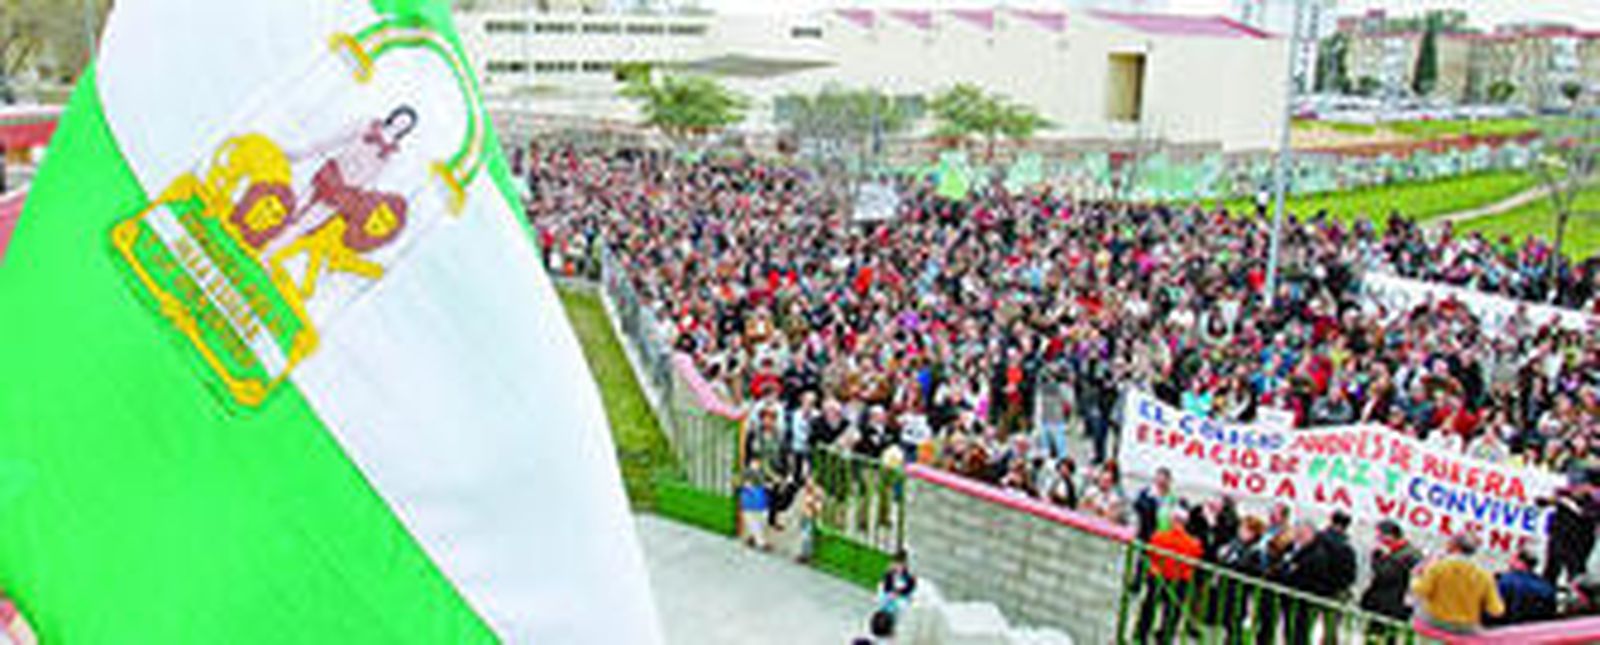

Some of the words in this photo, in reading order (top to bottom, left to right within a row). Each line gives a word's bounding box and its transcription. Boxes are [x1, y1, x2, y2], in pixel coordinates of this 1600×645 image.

[1138, 398, 1167, 426] EL
[1136, 423, 1261, 470] ESPACIO
[1268, 453, 1299, 474] DE
[1307, 453, 1371, 488] PAZ
[1221, 469, 1266, 494] NO
[1274, 477, 1297, 499] A
[1314, 480, 1353, 508] LA
